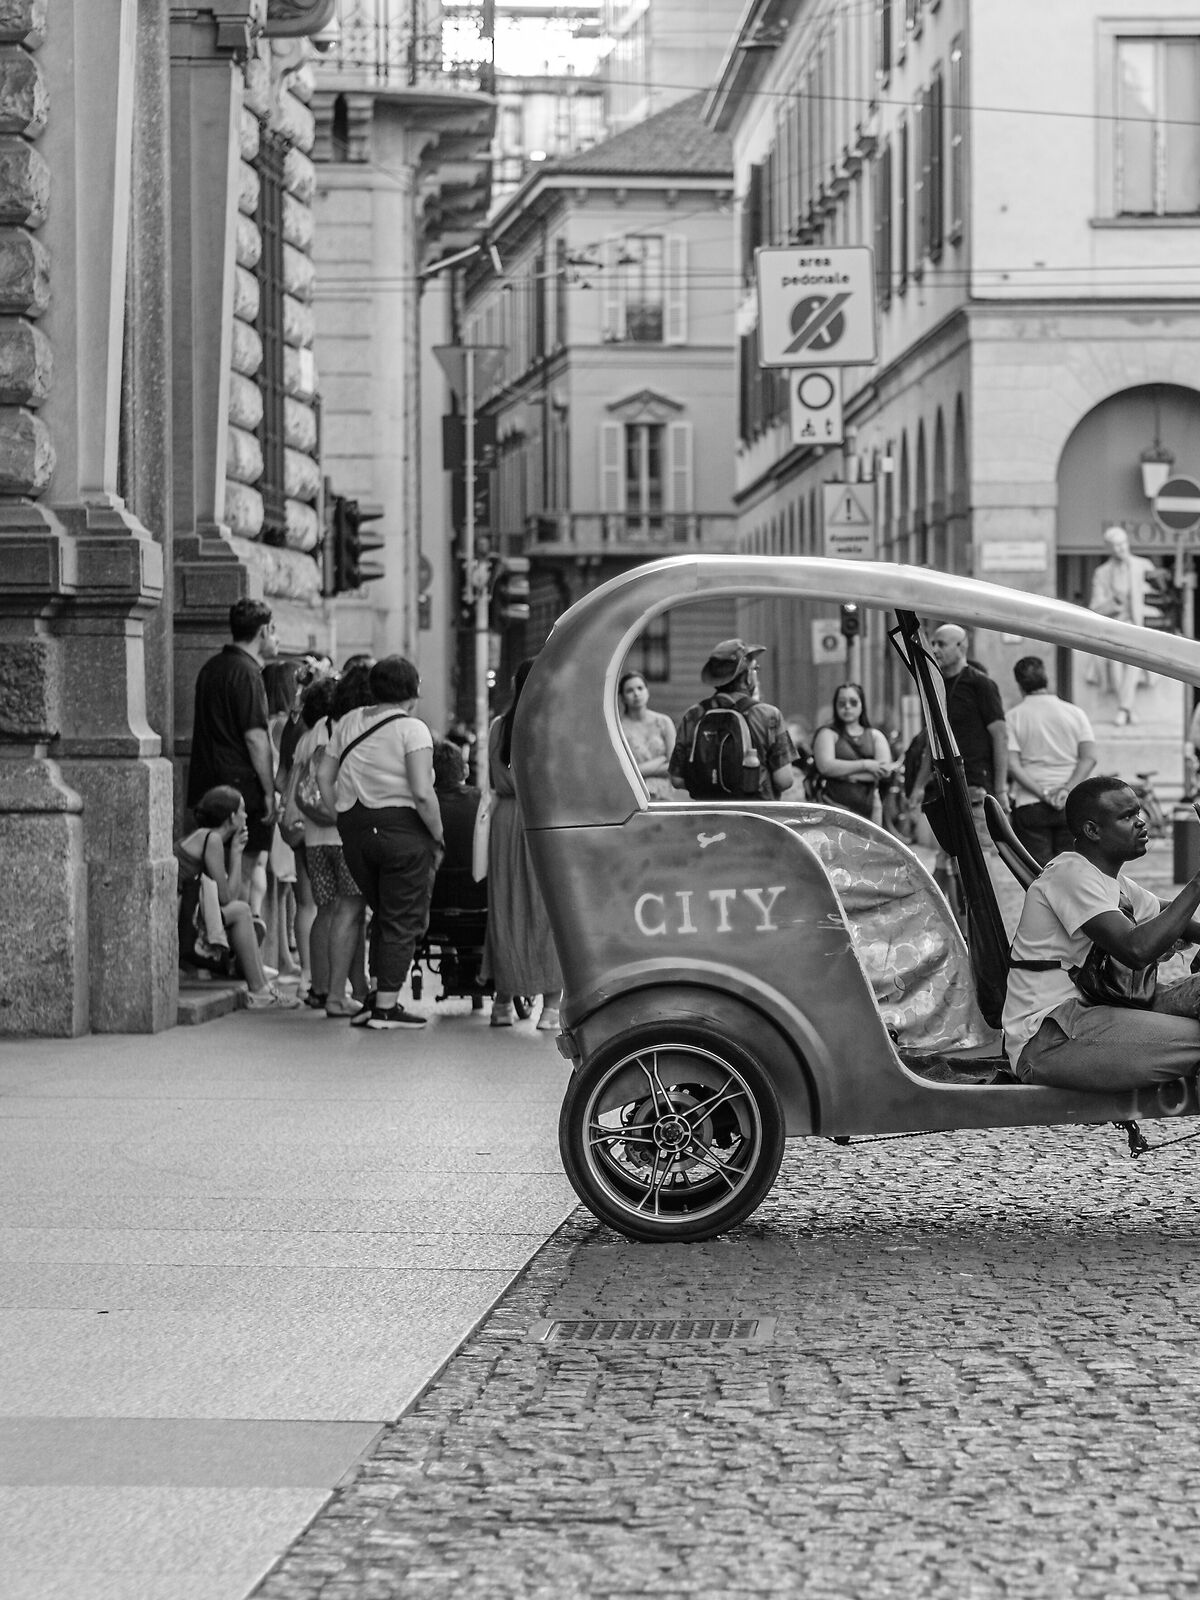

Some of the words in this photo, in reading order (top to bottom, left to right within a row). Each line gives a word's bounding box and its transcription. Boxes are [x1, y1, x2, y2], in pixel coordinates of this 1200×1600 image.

[799, 258, 831, 268] area
[781, 273, 850, 287] pedonale
[634, 886, 787, 937] CITY
